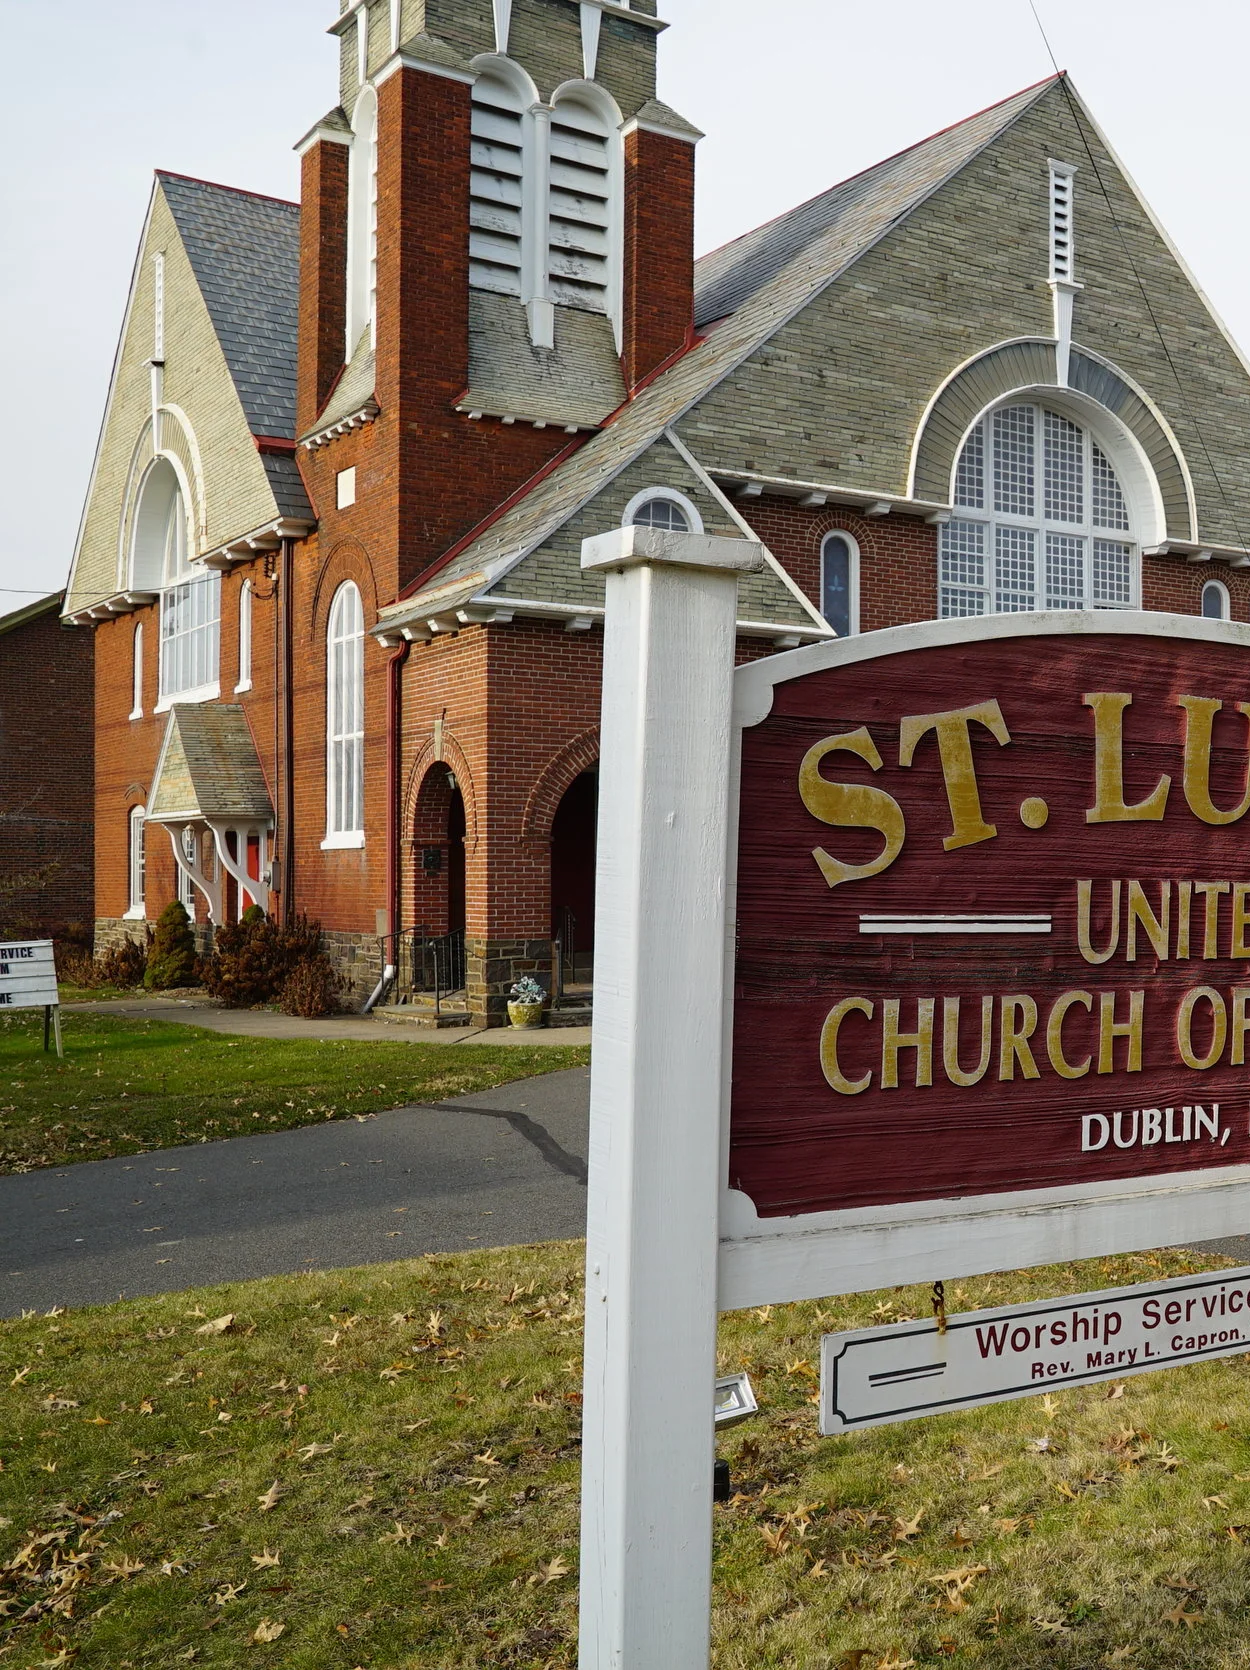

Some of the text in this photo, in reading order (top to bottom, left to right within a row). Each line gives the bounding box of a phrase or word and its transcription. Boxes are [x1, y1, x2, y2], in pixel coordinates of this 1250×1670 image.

[799, 699, 1048, 888] ST.
[820, 990, 1145, 1095] CHURCH
[1081, 1103, 1231, 1152] DUBLIN,
[975, 1308, 1122, 1358] Worship
[1031, 1361, 1074, 1379] Rev.
[1087, 1348, 1137, 1369] Mary
[1144, 1342, 1160, 1358] L.
[1171, 1327, 1246, 1351] Capron,
